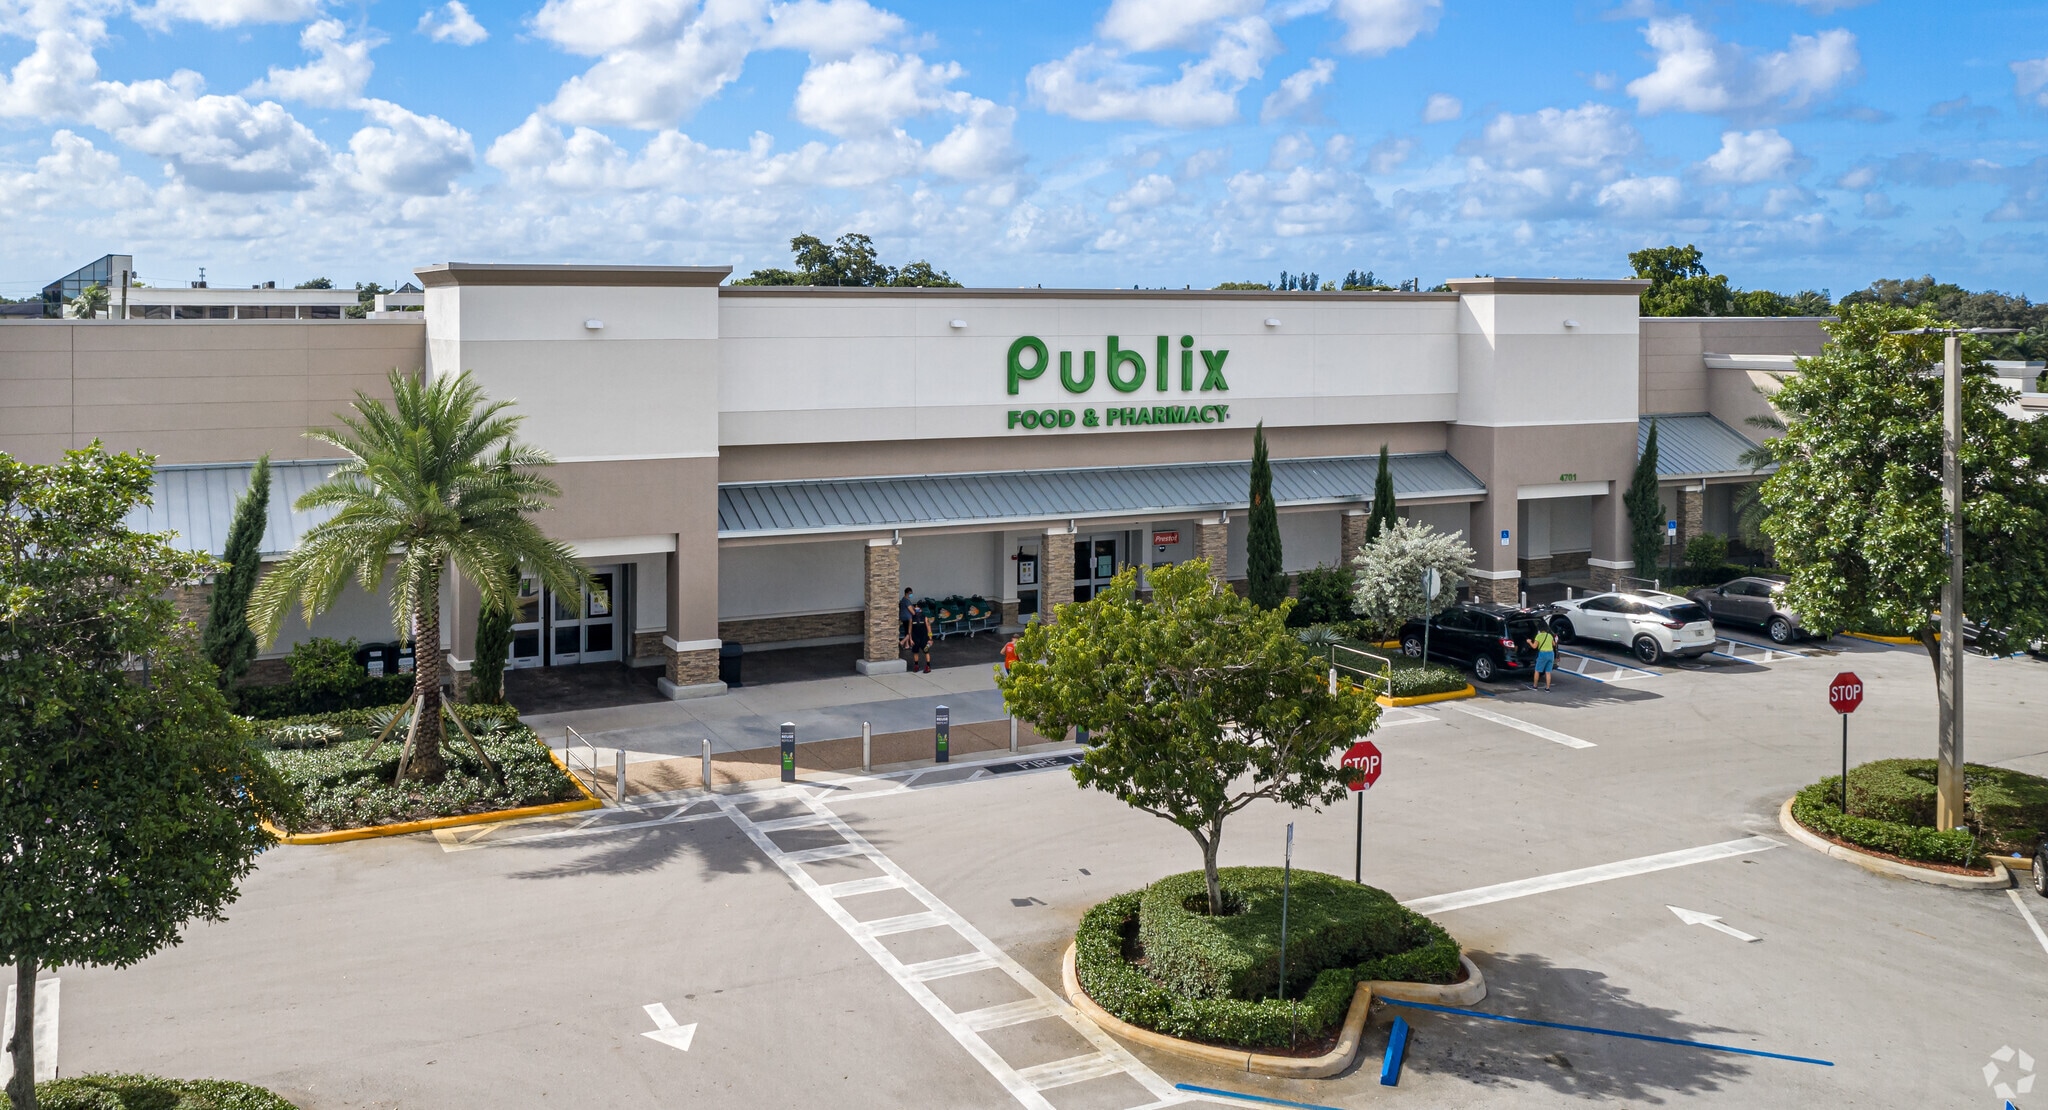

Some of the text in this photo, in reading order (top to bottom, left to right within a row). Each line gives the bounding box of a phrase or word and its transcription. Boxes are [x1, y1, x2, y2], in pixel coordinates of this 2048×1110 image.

[1007, 335, 1230, 395] Publix
[1008, 405, 1229, 429] FOOD & PHARMACY
[1559, 473, 1577, 481] 4701
[1831, 684, 1861, 702] STOP
[1016, 757, 1065, 770] FIRE
